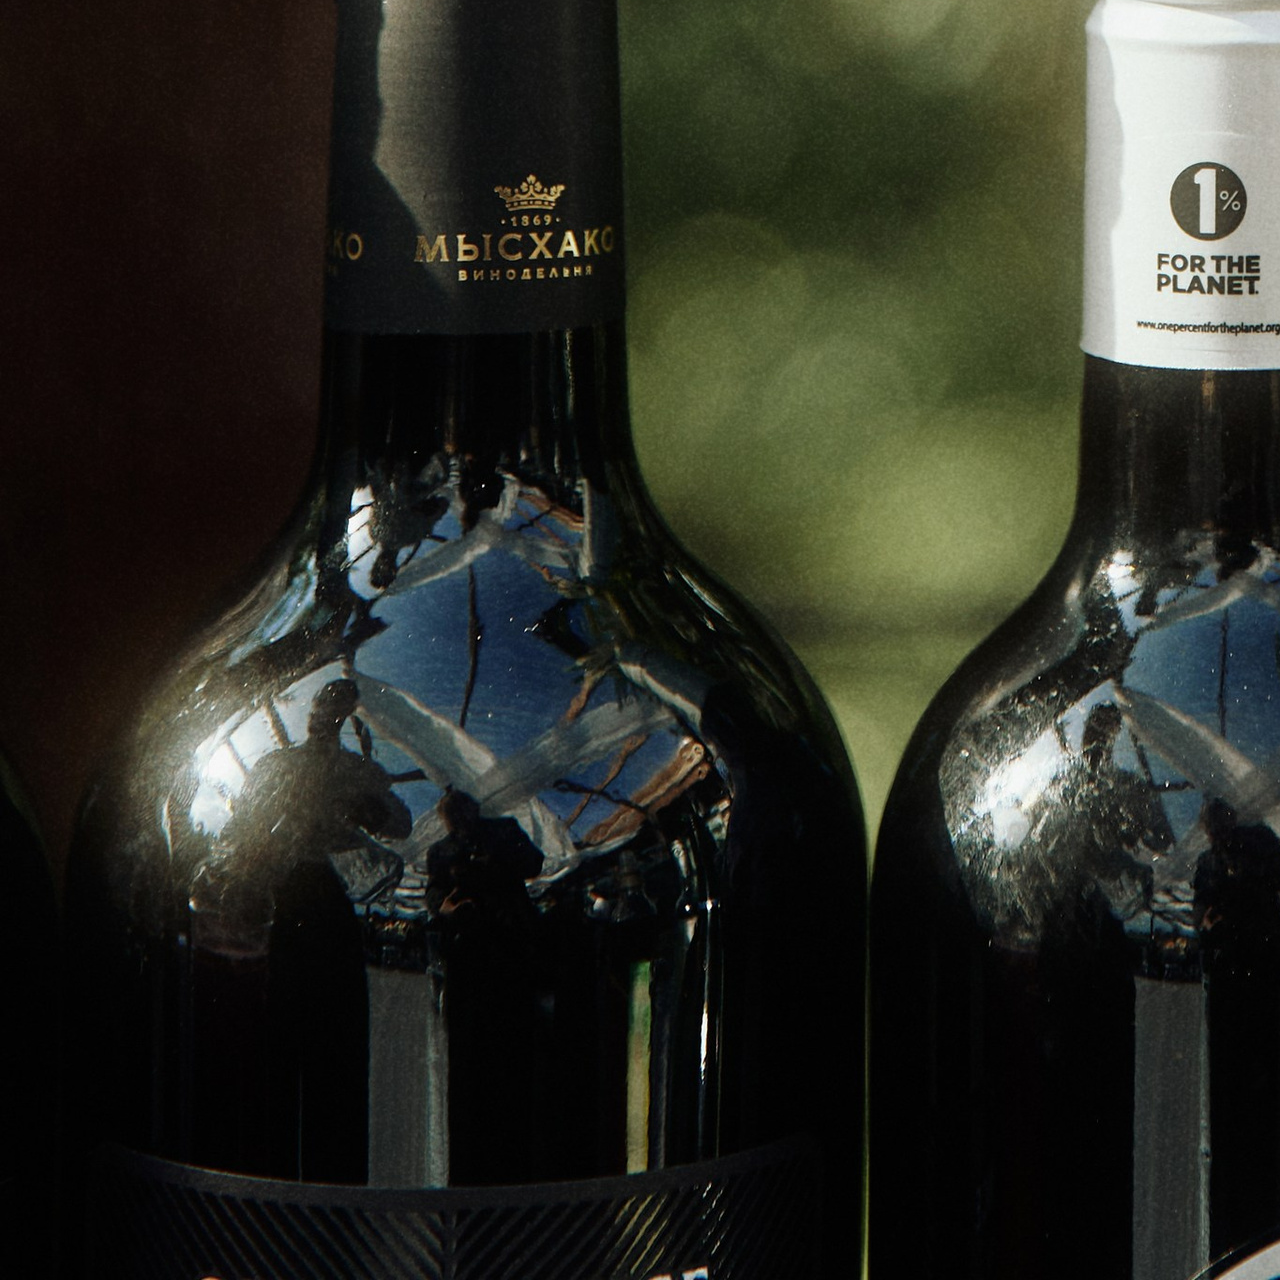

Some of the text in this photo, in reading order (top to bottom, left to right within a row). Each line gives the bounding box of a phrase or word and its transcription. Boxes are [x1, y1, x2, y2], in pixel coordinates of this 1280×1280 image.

[1193, 168, 1241, 235] 1%
[413, 225, 614, 263] МЫСХАКО
[457, 265, 593, 282] ВИНОДЕЛЬНЯ
[1156, 253, 1261, 274] FOR THE
[1136, 320, 1280, 336] www.onepercentfortheplanet.org
